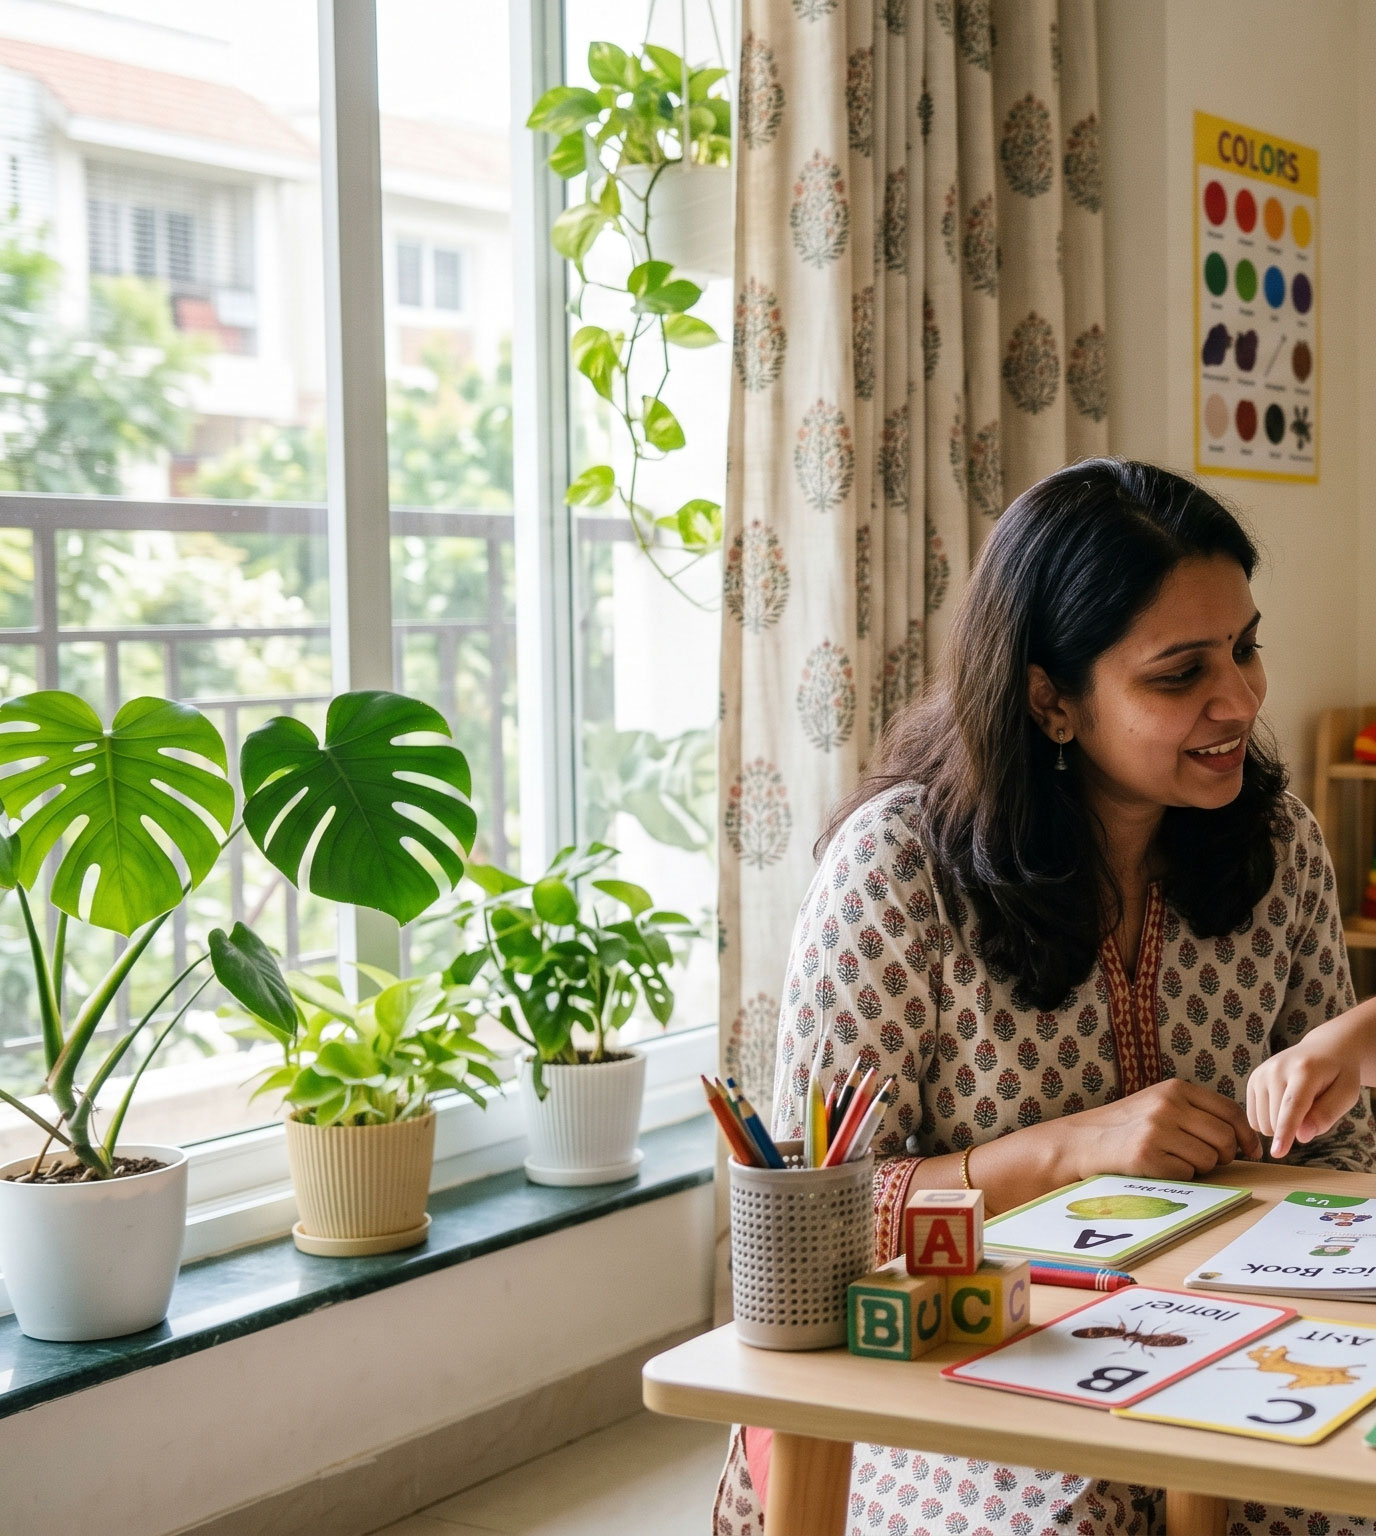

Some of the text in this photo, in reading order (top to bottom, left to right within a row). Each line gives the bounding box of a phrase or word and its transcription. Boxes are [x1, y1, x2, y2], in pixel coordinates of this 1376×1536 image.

[1218, 130, 1299, 184] COLORS
[918, 1219, 963, 1264] A
[1073, 1229, 1133, 1249] A
[1242, 1262, 1322, 1278] Book
[951, 1287, 992, 1334] C
[1009, 1279, 1025, 1322] C
[861, 1299, 900, 1347] B
[1076, 1367, 1148, 1393] B
[1246, 1398, 1316, 1424] C
